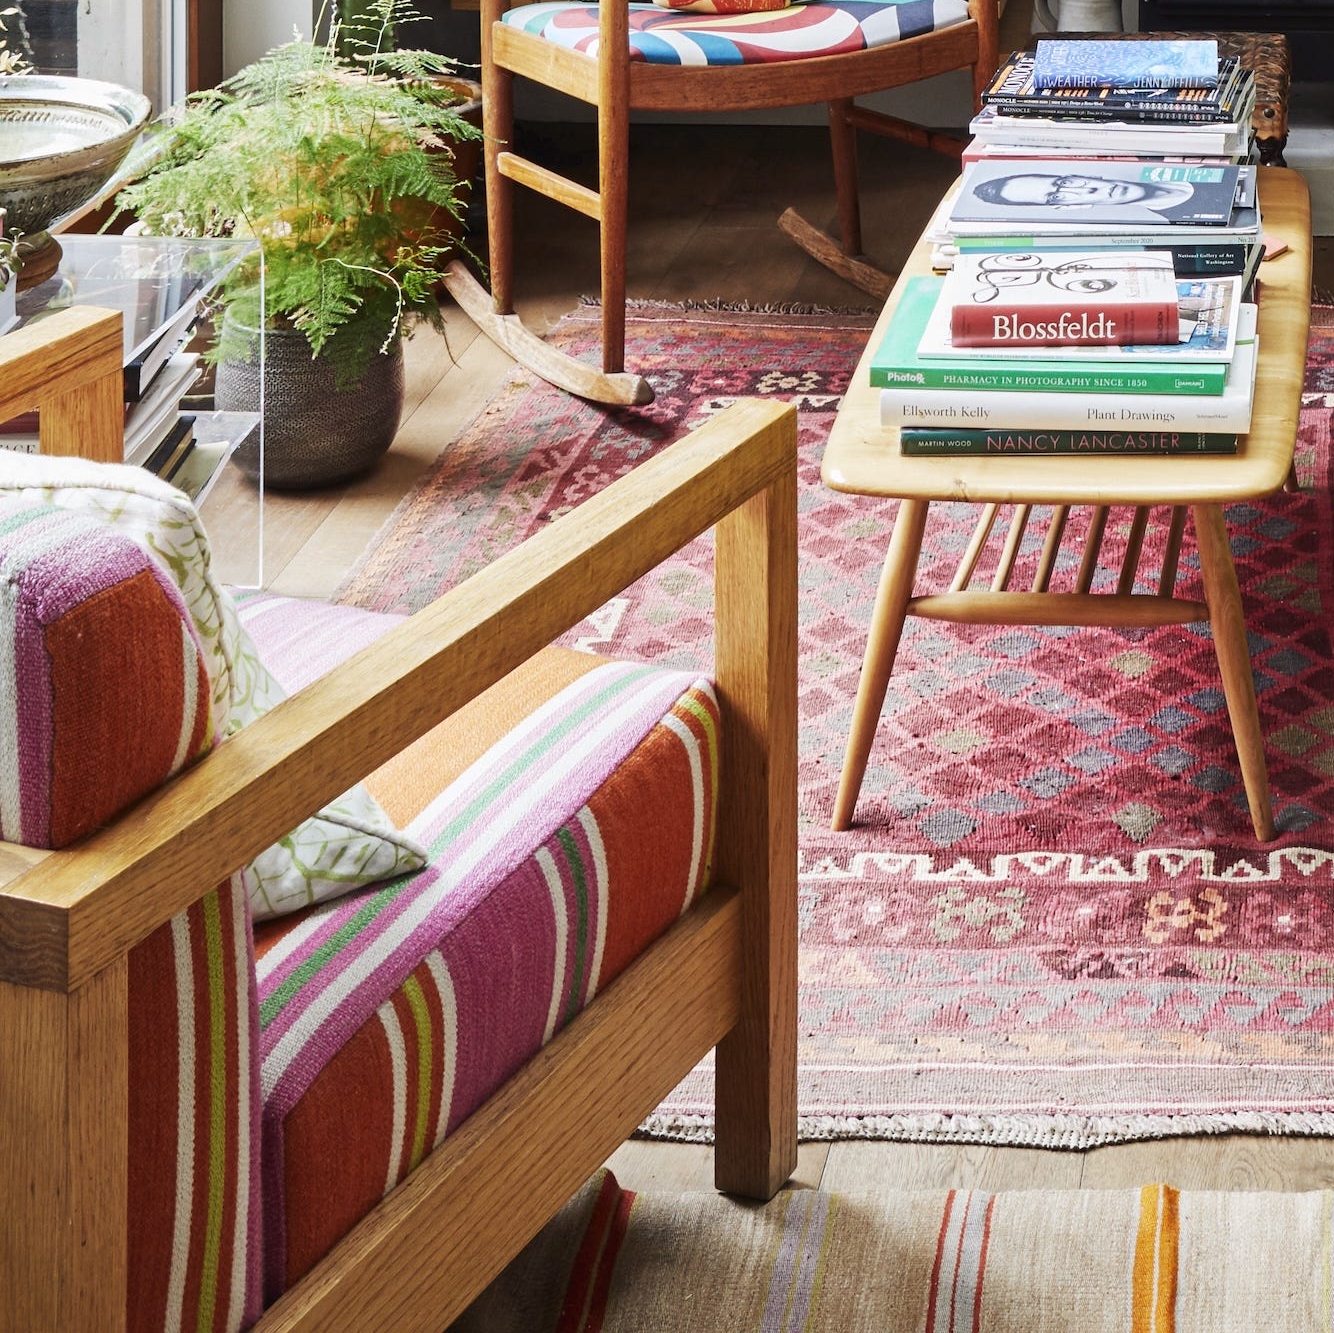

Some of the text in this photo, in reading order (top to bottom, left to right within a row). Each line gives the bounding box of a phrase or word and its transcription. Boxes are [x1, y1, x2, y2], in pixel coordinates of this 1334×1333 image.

[1046, 76, 1098, 88] WEATHER
[1133, 75, 1168, 87] JENNY
[987, 97, 1017, 105] MONOCLE
[1002, 106, 1031, 114] MONOCLE
[992, 312, 1116, 341] Blossfeldt
[943, 374, 1148, 388] PHARMACY IN PHOTOGRAPHY SINCE 1850
[902, 404, 1176, 423] Ellsworth Kelly Plant Drawings
[918, 433, 1181, 451] MARTIN WOOD NANCY LANCASTER
